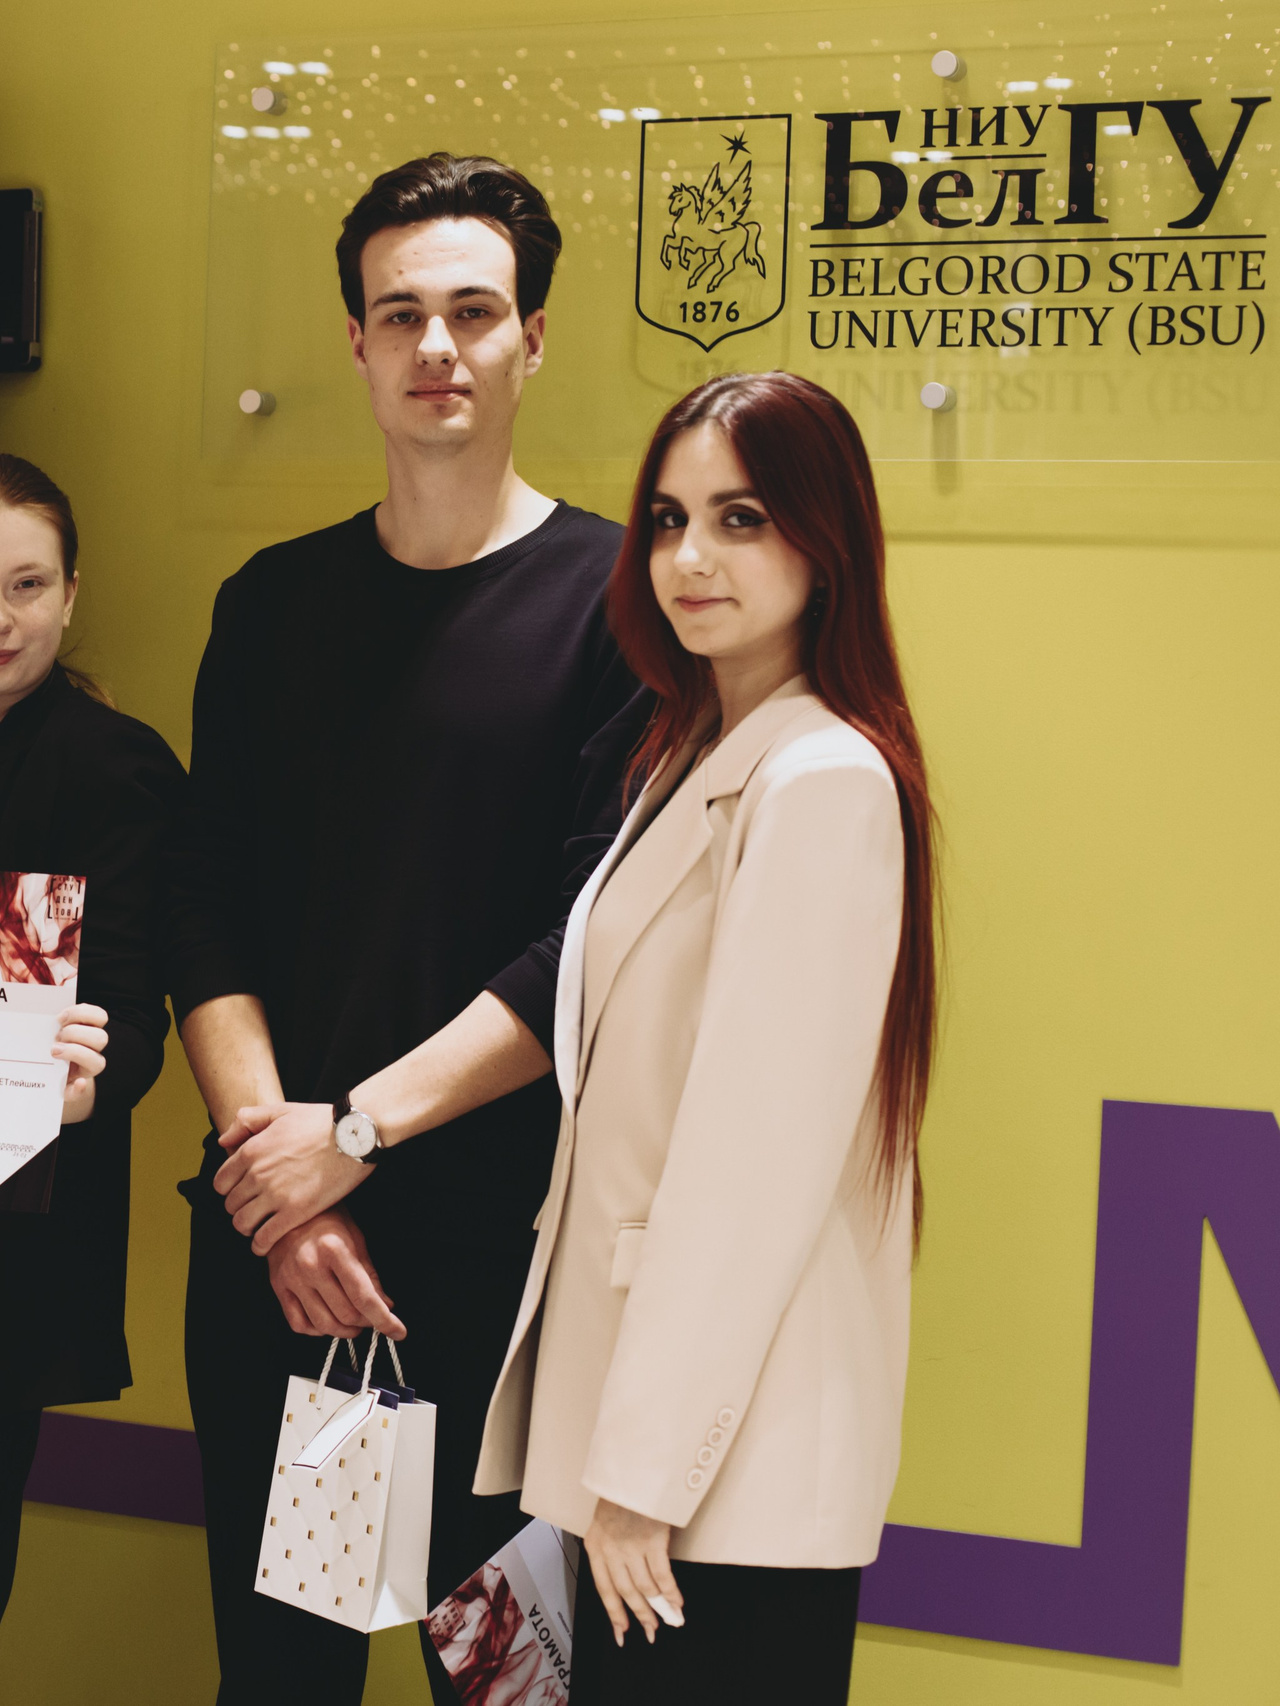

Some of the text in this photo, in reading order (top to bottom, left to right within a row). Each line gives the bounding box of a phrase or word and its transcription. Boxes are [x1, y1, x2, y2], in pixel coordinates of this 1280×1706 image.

[919, 104, 1052, 148] НИУ
[810, 96, 1272, 231] БелГУ
[807, 250, 1267, 298] BELGOROD STATE
[678, 300, 741, 324] 1876
[807, 301, 1267, 356] UNIVERSITY (BSU)
